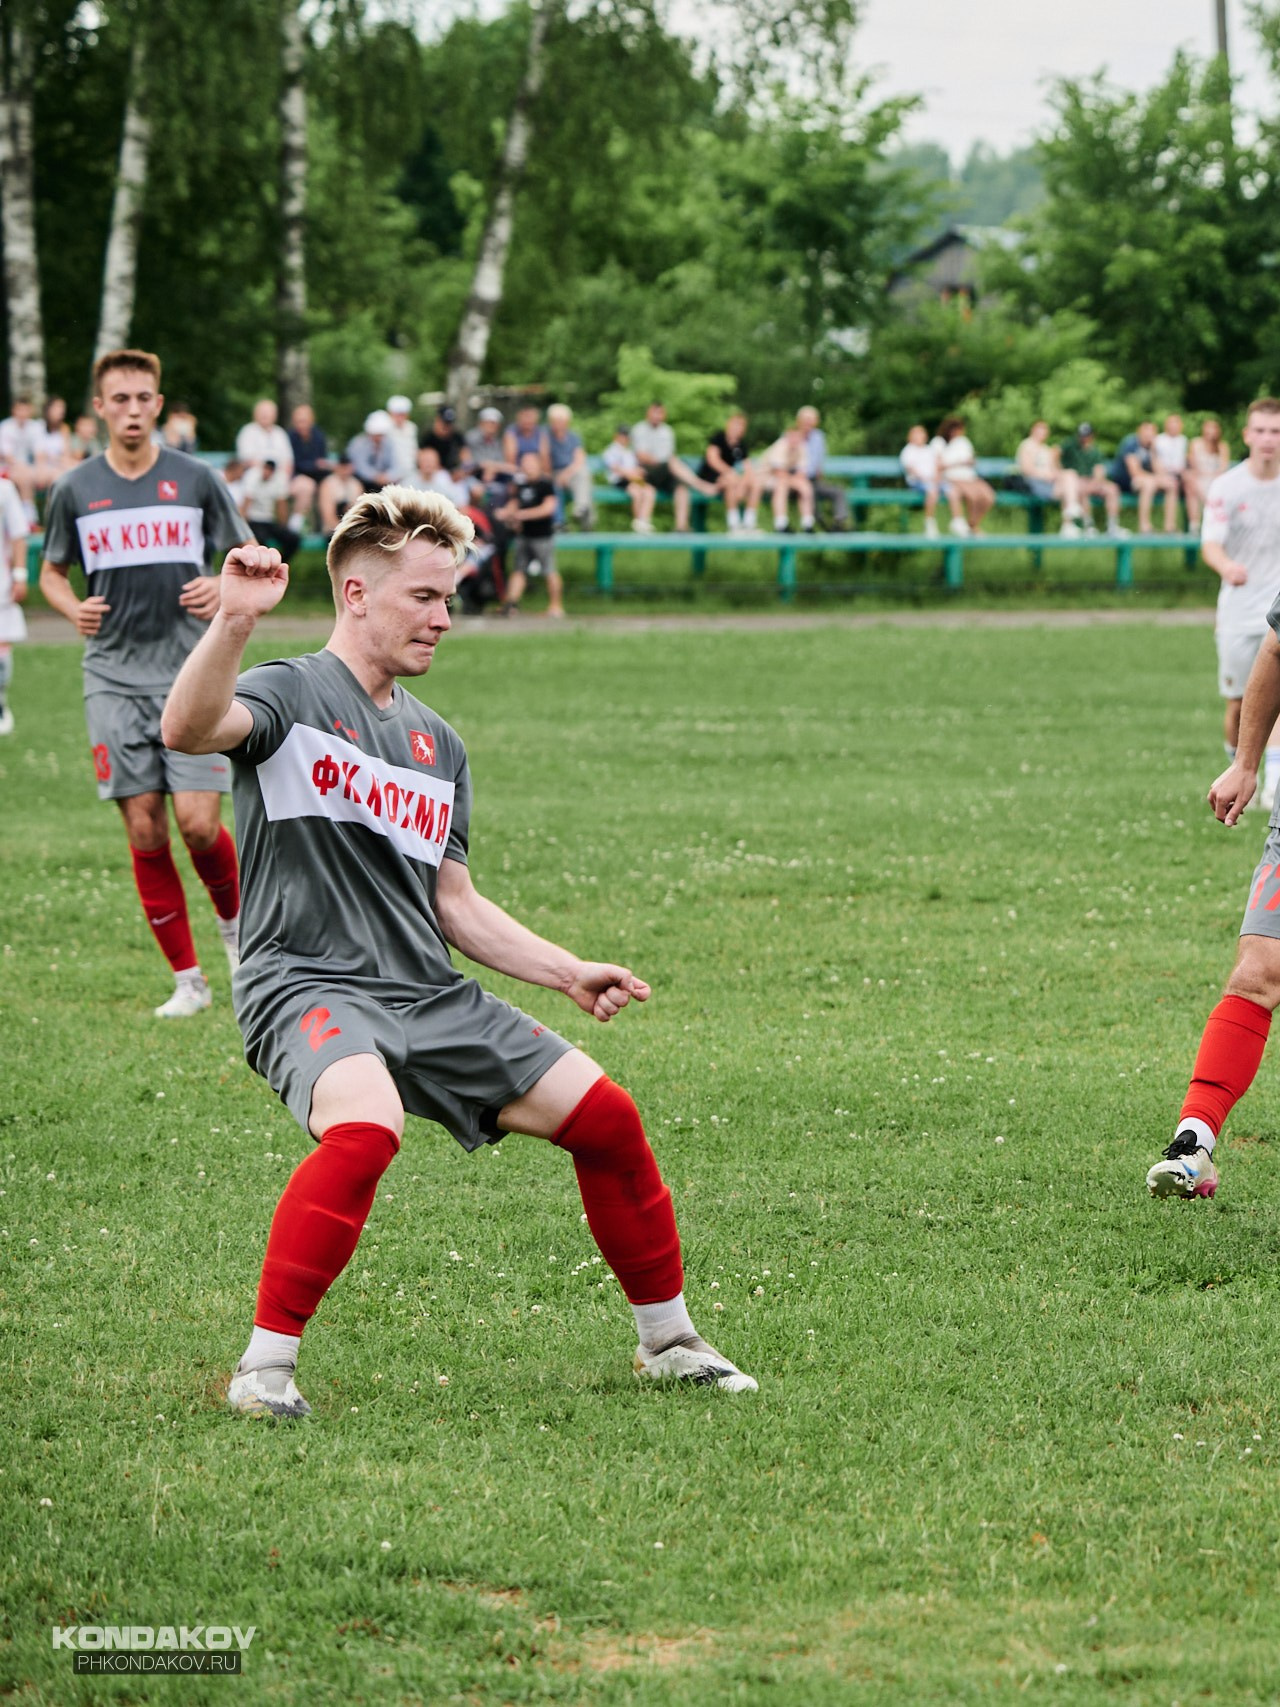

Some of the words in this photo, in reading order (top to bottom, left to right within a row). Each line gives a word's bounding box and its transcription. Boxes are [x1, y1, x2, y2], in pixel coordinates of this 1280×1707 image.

[120, 520, 191, 550] КОХМА
[312, 754, 361, 804] ФК
[300, 1006, 341, 1053] 2
